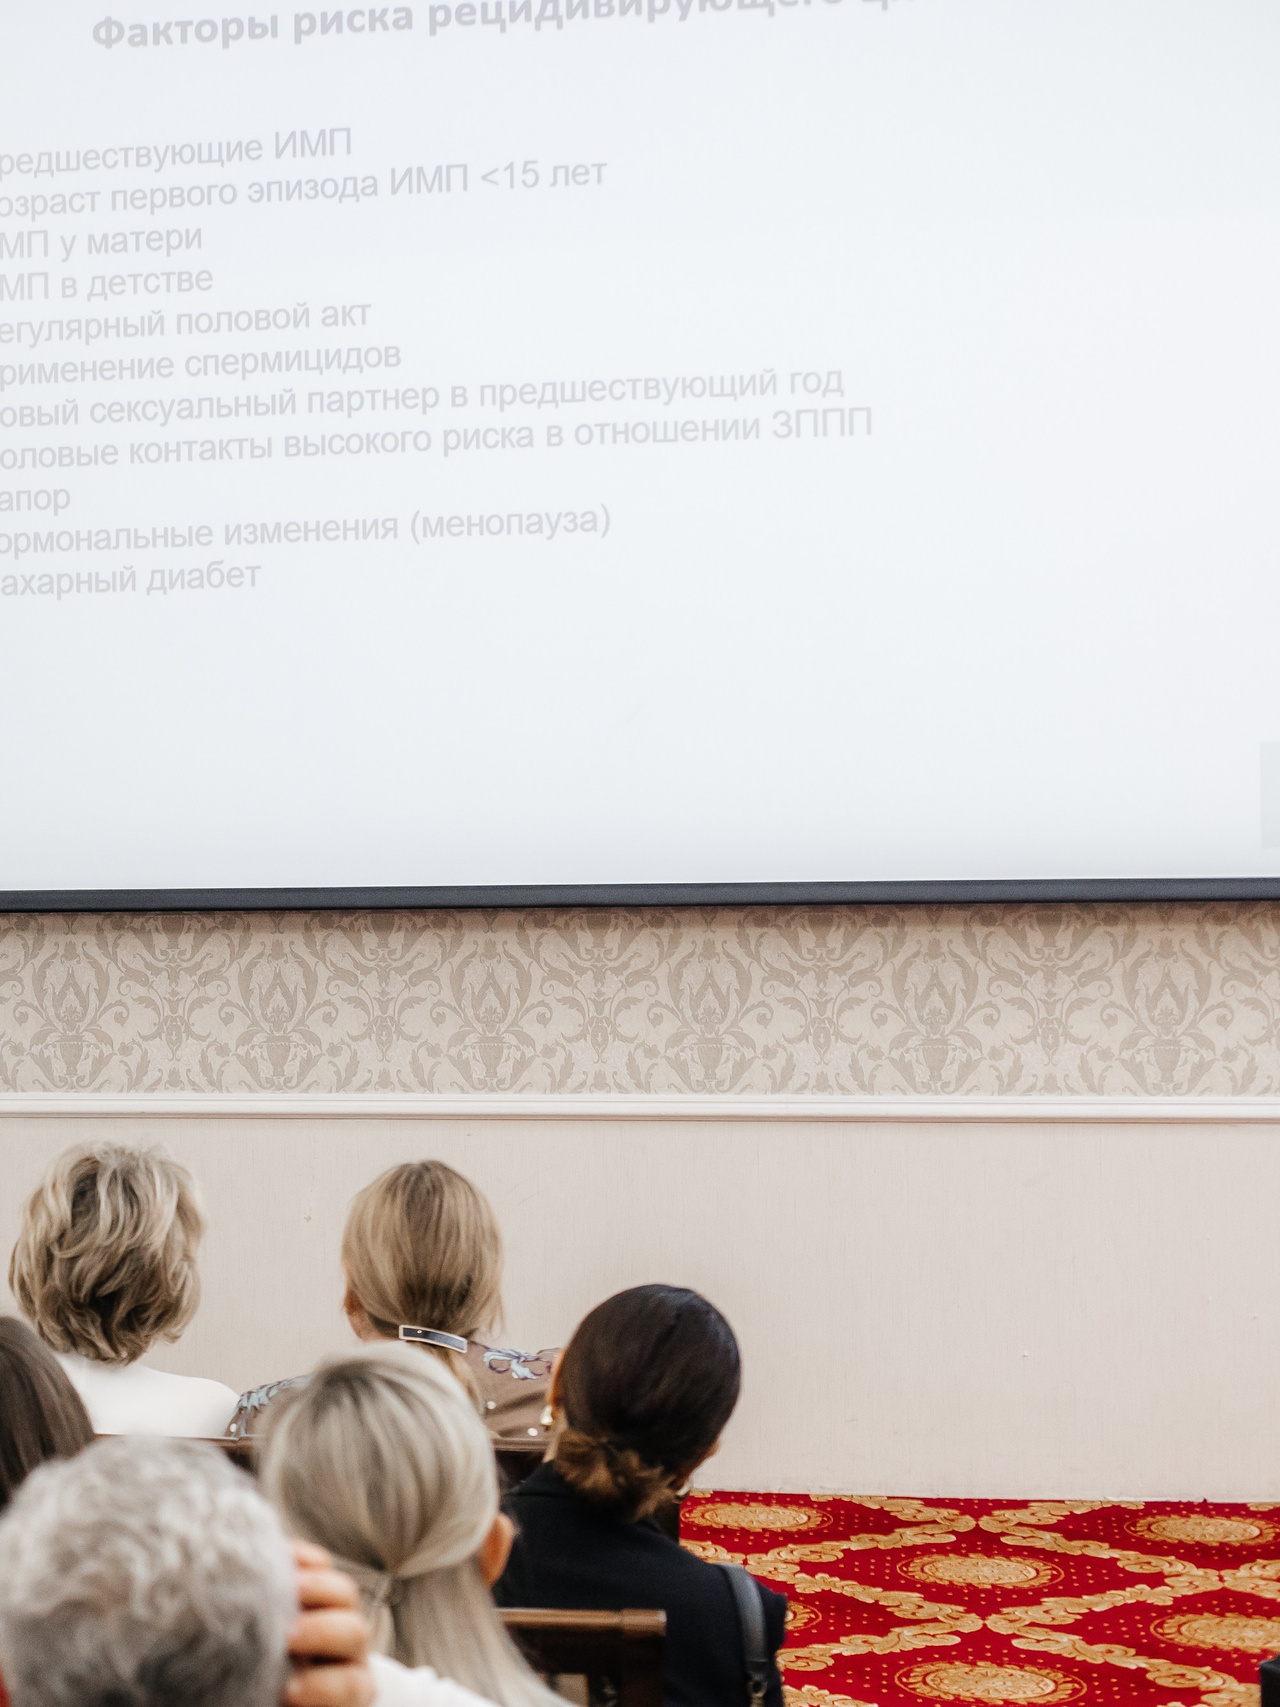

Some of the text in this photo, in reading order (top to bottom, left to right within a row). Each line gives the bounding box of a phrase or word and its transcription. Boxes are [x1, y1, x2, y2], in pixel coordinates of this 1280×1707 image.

[92, 10, 278, 49] Факторы
[293, 4, 414, 44] риска
[274, 127, 352, 160] ИМП
[111, 179, 237, 215] первого
[247, 171, 379, 204] эпизода
[390, 163, 468, 196] ИМП
[481, 160, 540, 190] <15
[549, 161, 608, 188] лет
[59, 232, 77, 262] у
[87, 226, 203, 259] матери
[61, 274, 77, 299] в
[87, 266, 214, 303] детстве
[176, 301, 311, 336] половой
[321, 301, 372, 329] акт
[185, 343, 402, 381] спермицидов
[89, 387, 296, 428] сексуальный
[307, 387, 440, 418] партнер
[451, 385, 468, 408] в
[479, 368, 778, 412] предшествующий
[790, 369, 845, 399] год
[129, 434, 273, 465] контакты
[284, 428, 432, 460] высокого
[442, 424, 535, 458] риска
[546, 424, 563, 447] в
[574, 418, 761, 447] отношении
[772, 407, 873, 440] ЗППП
[224, 517, 398, 547] изменения
[410, 503, 611, 545] (менопауза)
[147, 560, 262, 596] диабет
